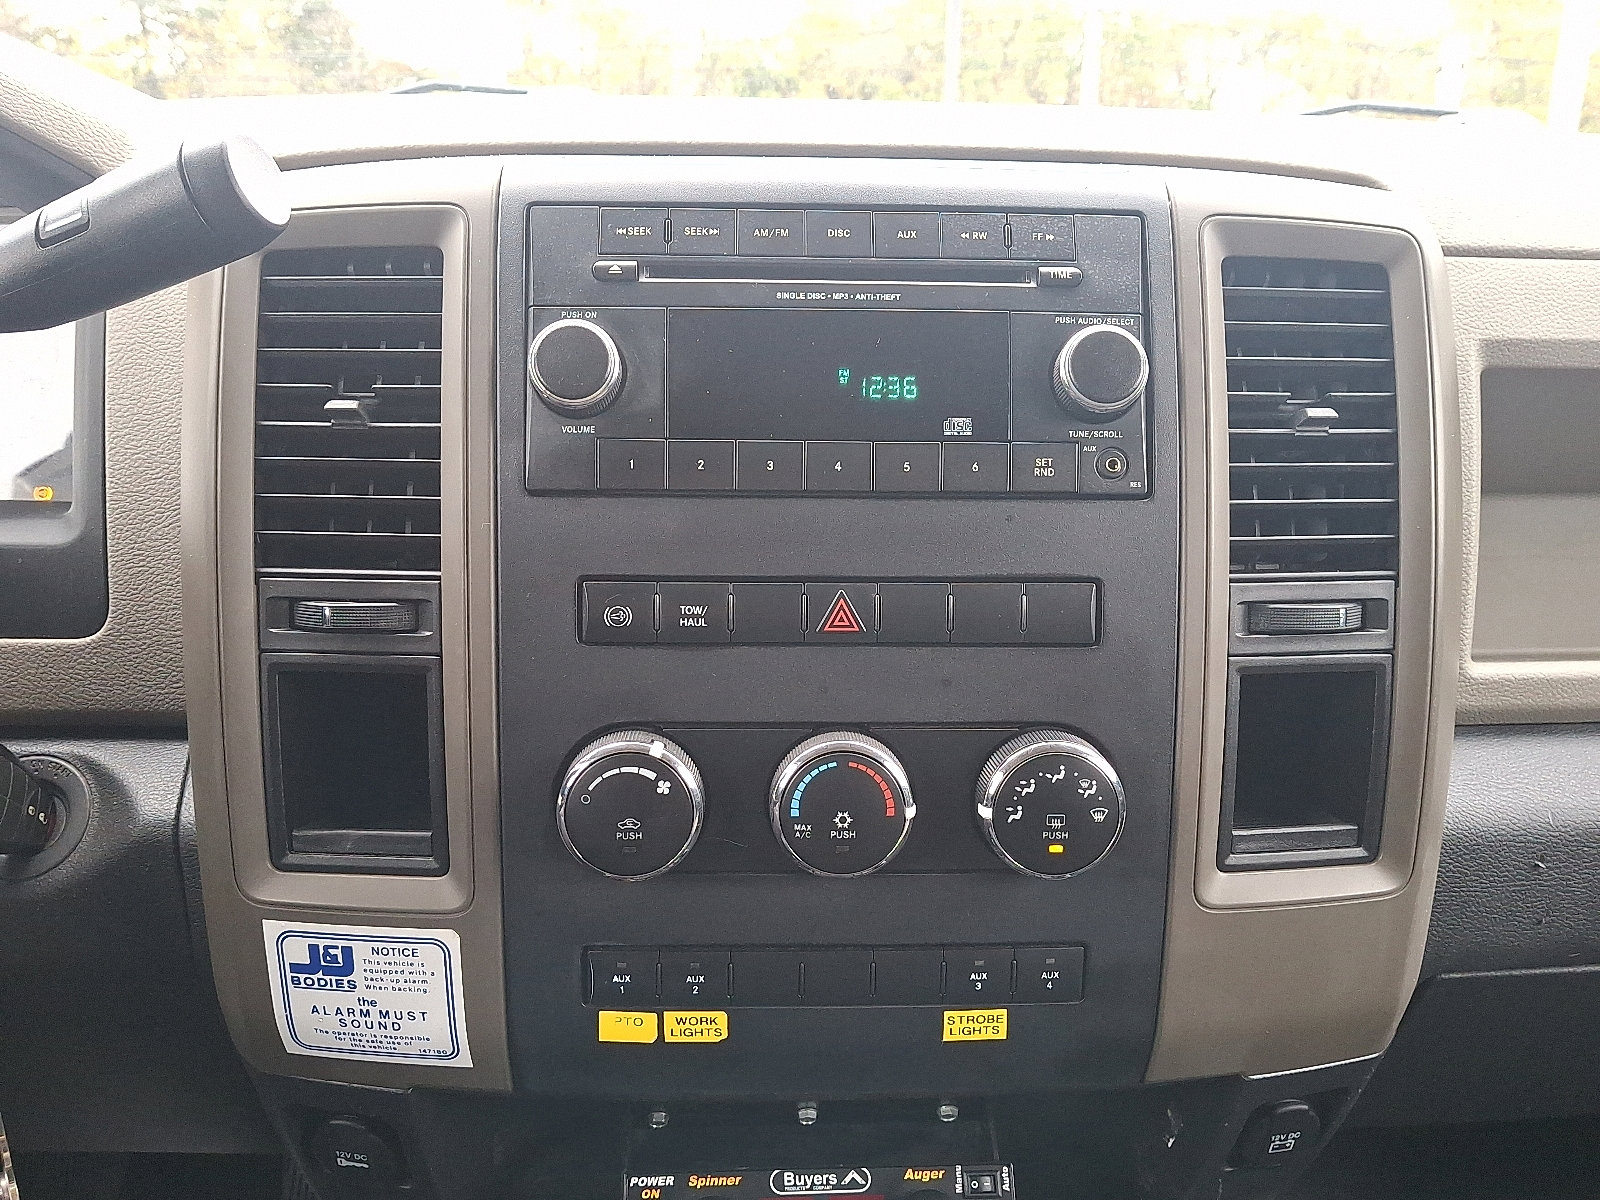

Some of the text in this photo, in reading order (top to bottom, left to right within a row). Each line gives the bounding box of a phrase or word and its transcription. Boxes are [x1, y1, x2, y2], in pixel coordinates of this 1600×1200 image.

[627, 226, 652, 236] SEEK
[684, 227, 708, 237] SEEK
[753, 228, 789, 239] AM/FM
[827, 228, 851, 238] DISC
[897, 230, 917, 239] AUX
[972, 231, 988, 240] RW
[1032, 232, 1044, 241] FF
[1050, 270, 1073, 280] TIME
[776, 291, 902, 301] SINGLE DISC MP3 ANTI-THEFT
[561, 310, 597, 319] PUSH ON
[1055, 316, 1135, 326] PUSH AUDIO/SELECT
[838, 369, 850, 377] FM
[839, 376, 849, 384] ST
[862, 376, 917, 399] 12:36
[561, 425, 596, 434] VOLUME
[1068, 430, 1124, 440] TUNE/SCROLL
[628, 459, 635, 470] 1
[697, 460, 704, 470] 2
[766, 461, 774, 471] 3
[834, 461, 842, 472] 4
[903, 461, 911, 472] 5
[972, 461, 979, 472] 6
[1035, 458, 1054, 467] SET
[1034, 468, 1055, 477] RND
[680, 604, 708, 617] TOW/
[679, 617, 708, 628] HAUL
[616, 832, 643, 841] PUSH
[794, 831, 811, 839] A/C
[830, 830, 856, 840] PUSH
[1042, 831, 1069, 840] PUSH
[371, 946, 420, 958] NOTICE
[289, 943, 355, 978] J&J
[362, 958, 381, 966] This
[363, 967, 405, 976] equipped
[969, 972, 988, 980] AUX
[1041, 971, 1060, 979] AUX
[290, 975, 358, 990] BODIES
[363, 975, 401, 984] back-up
[612, 974, 631, 983] AUX
[686, 975, 705, 983] AUX
[364, 983, 389, 991] When
[619, 985, 625, 994] 1
[692, 986, 699, 994] 2
[975, 982, 982, 990] 3
[1046, 981, 1053, 990] 4
[357, 996, 378, 1008] the
[311, 1004, 428, 1022] ALARM MUST
[615, 1016, 644, 1027] PTO
[675, 1016, 719, 1026] WORK
[947, 1014, 1004, 1025] STROBE
[338, 1018, 402, 1032] SOUND
[313, 1027, 329, 1035] The
[331, 1030, 368, 1038] operator
[670, 1027, 723, 1037] LIGHTS
[949, 1025, 1000, 1036] LIGHTS
[1288, 1132, 1301, 1140] DC
[336, 1151, 351, 1159] 12V
[783, 1171, 838, 1189] Buyers
[904, 1168, 945, 1182] Auger
[1001, 1165, 1010, 1192] Auto
[629, 1175, 675, 1187] POWER
[688, 1174, 742, 1188] Spinner
[641, 1188, 661, 1199] ON
